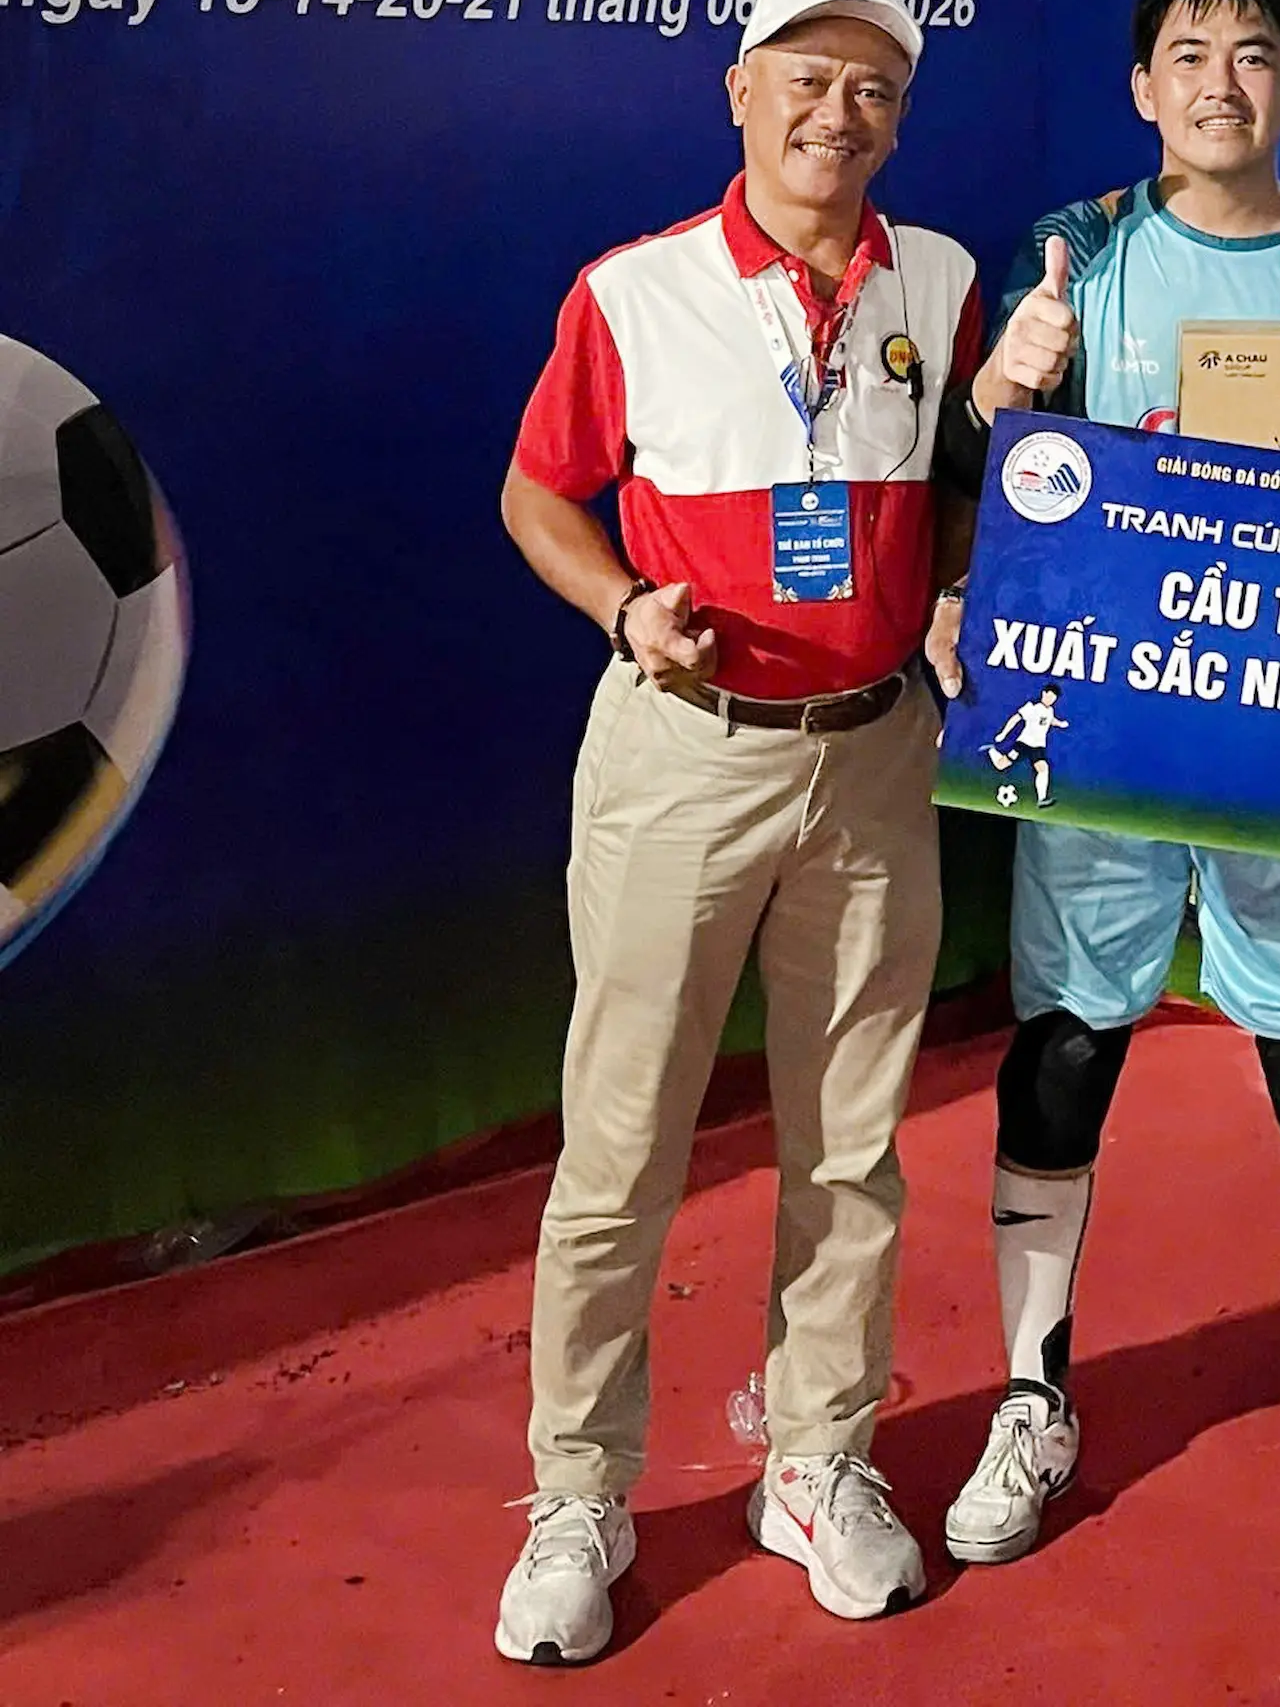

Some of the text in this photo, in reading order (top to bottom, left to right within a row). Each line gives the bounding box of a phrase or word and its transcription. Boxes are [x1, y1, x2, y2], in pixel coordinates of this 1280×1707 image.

[1156, 455, 1187, 476] GIẢI
[1235, 467, 1256, 487] ĐÁ
[1101, 501, 1225, 545] TRANH
[1158, 560, 1261, 631] CẦU
[985, 615, 1119, 684] XUẤT
[1126, 629, 1229, 702] SẮC
